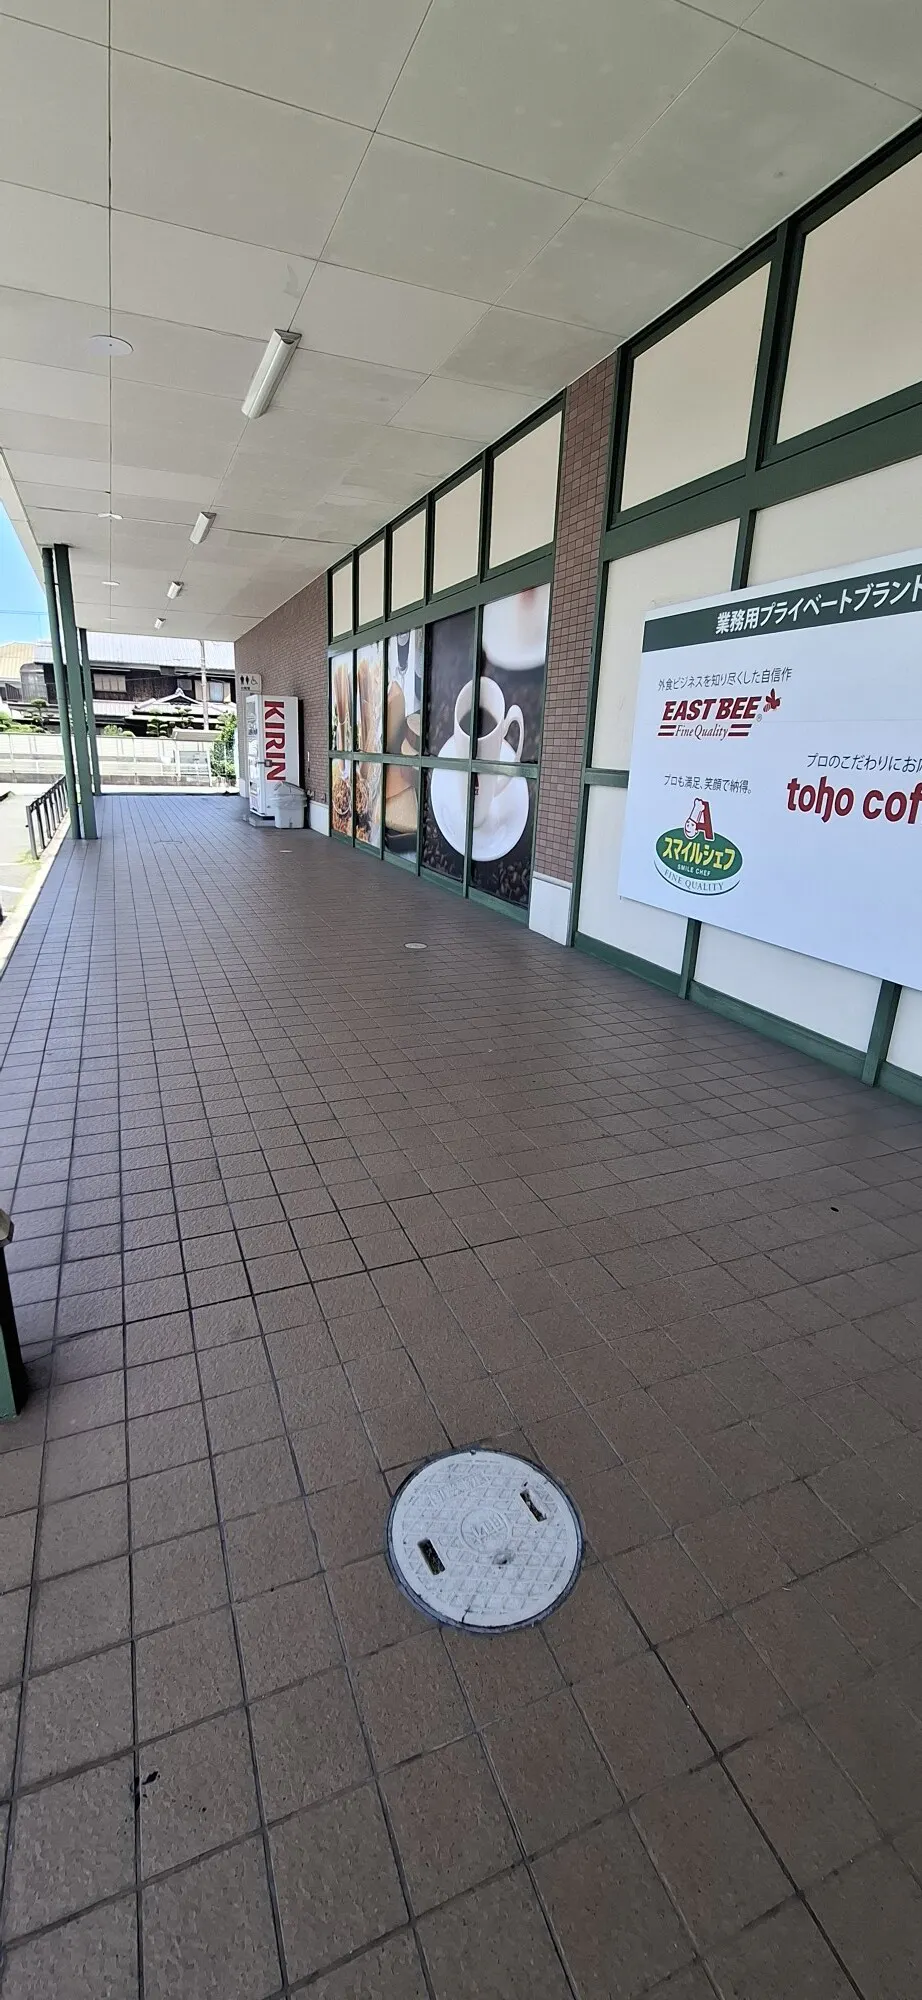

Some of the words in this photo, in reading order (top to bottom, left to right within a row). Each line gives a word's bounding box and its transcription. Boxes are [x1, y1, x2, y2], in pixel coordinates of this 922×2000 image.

[658, 667, 792, 692] 外食ビジネスを知り尽くした自信作
[662, 698, 717, 721] EAST
[715, 696, 762, 720] BEE
[264, 700, 286, 781] KIRIN
[675, 725, 694, 737] Fine
[694, 723, 729, 741] Quality
[664, 774, 752, 795] プロも満足、笑顔で納得。
[787, 776, 855, 823] toho
[662, 837, 736, 871] スマイルシェフ
[664, 869, 683, 886] FINE
[684, 880, 725, 893] QUALITY
[677, 864, 694, 874] SMILE
[695, 868, 711, 877] CHEF
